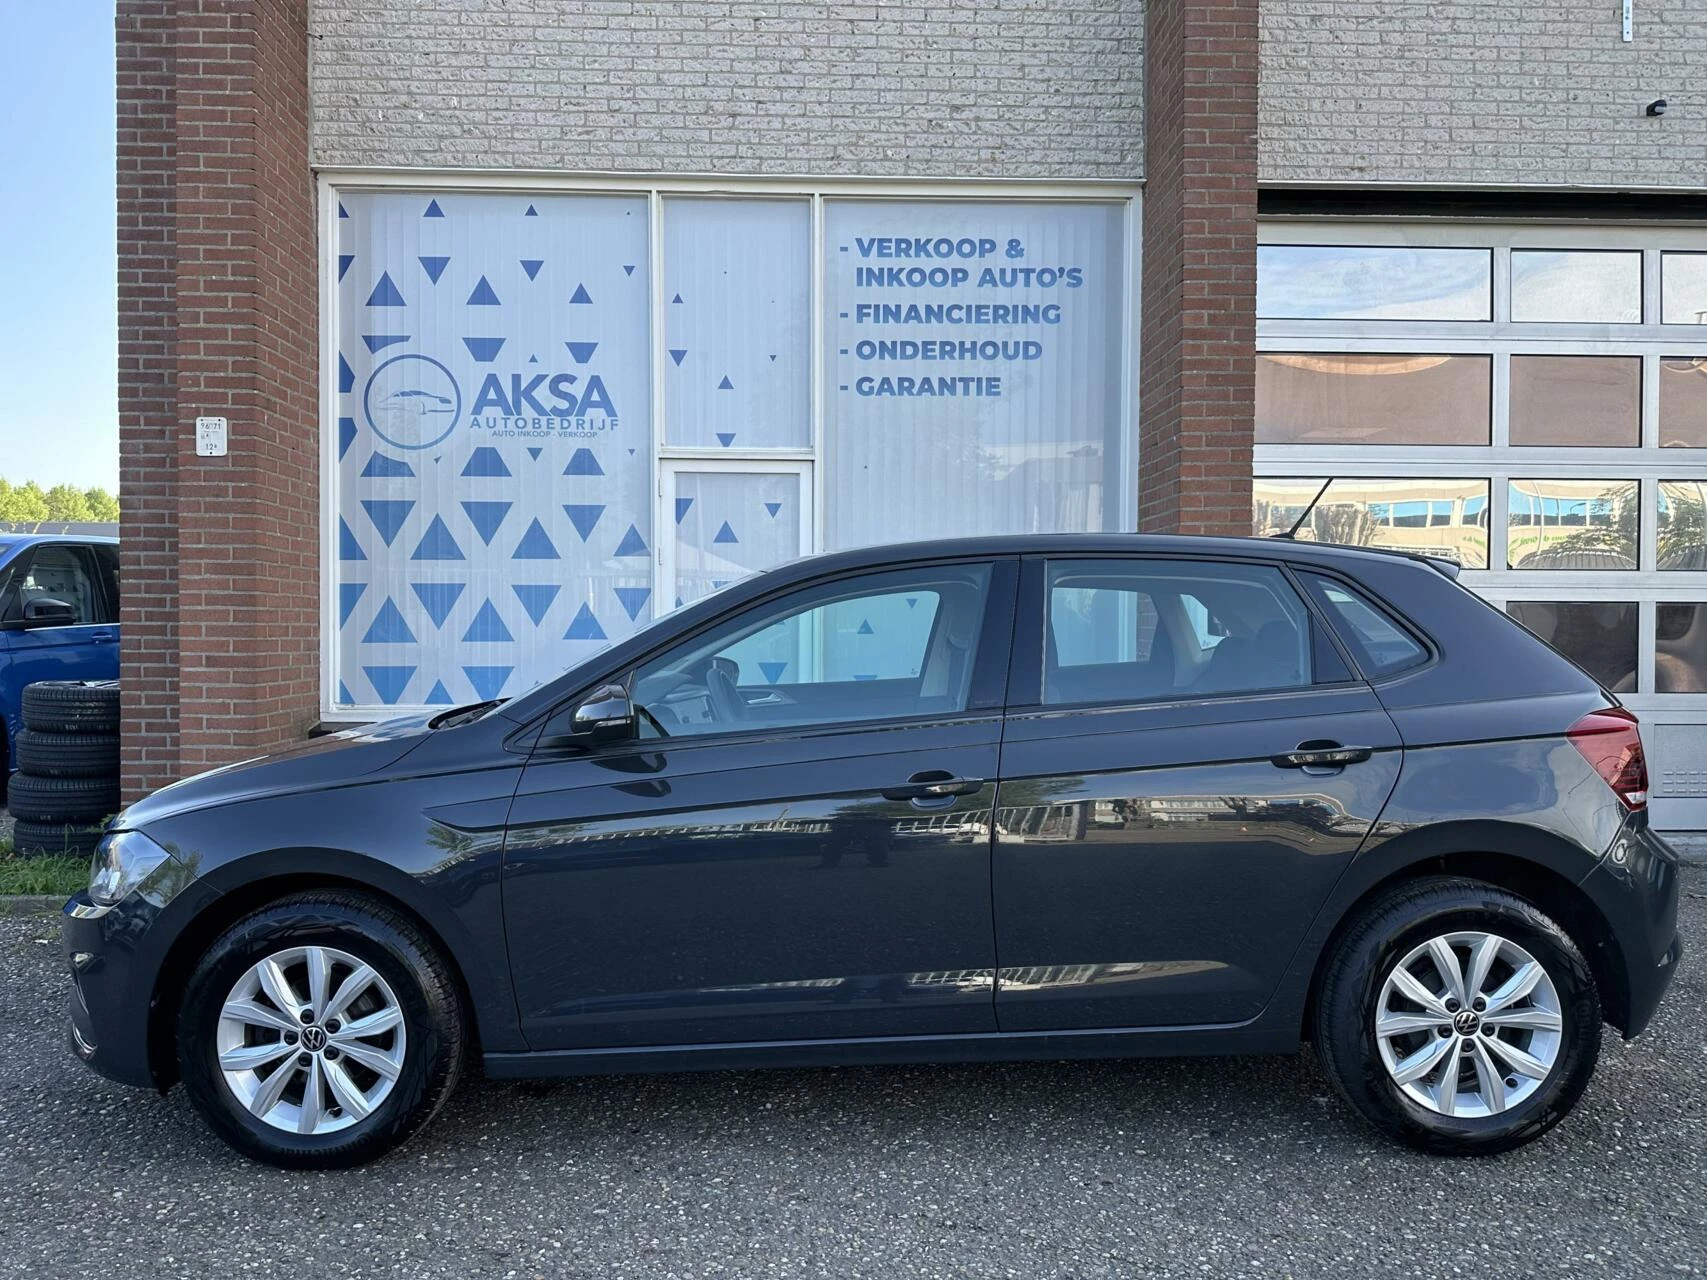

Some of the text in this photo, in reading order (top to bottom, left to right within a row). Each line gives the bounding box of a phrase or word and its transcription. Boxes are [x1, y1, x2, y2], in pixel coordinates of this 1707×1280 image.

[855, 238, 997, 259] VERKOOP
[1005, 238, 1025, 259] &
[856, 266, 1083, 288] INKOOP AUTO’S
[856, 304, 1061, 324] FINANCIERING
[855, 340, 1043, 361] ONDERHOUD
[470, 373, 619, 418] AKSA
[855, 376, 1002, 397] GARANTIE
[470, 416, 619, 431] AUTOBEDRIJF
[492, 430, 516, 438] AUTO
[517, 430, 550, 438] INKOOP
[558, 431, 598, 439] VERKOOP
